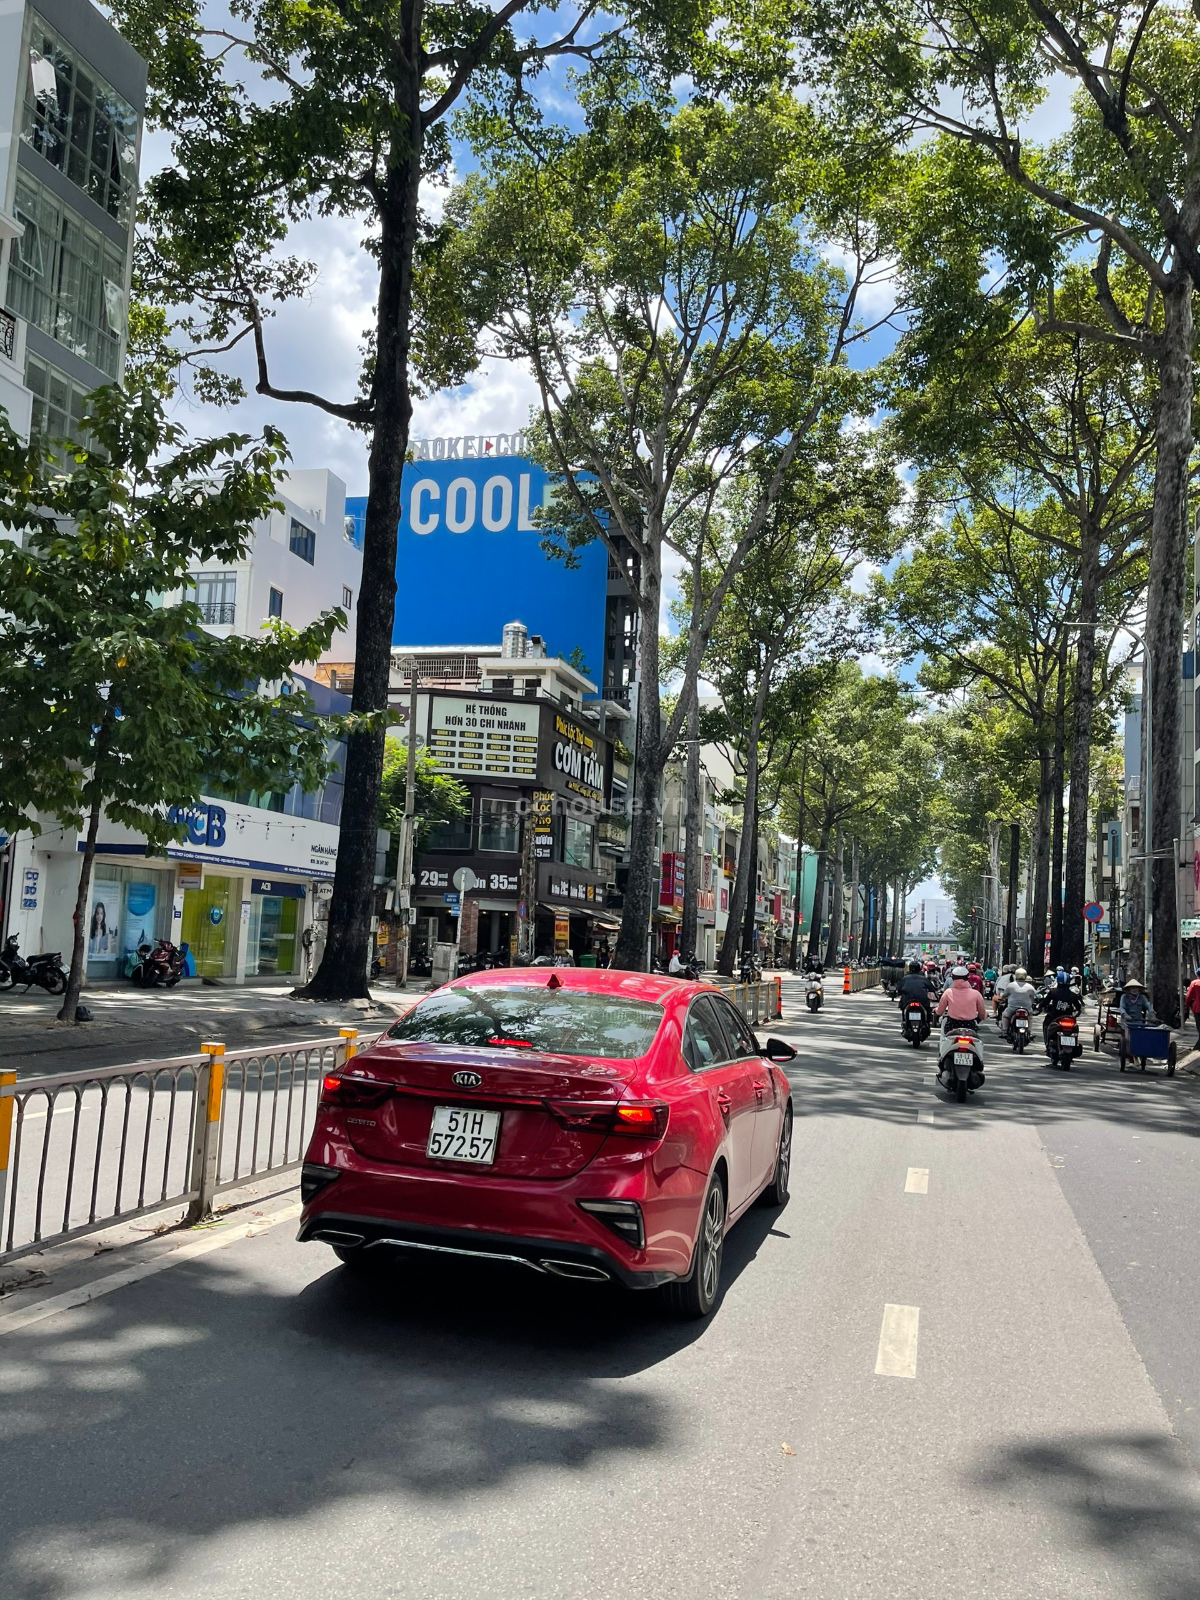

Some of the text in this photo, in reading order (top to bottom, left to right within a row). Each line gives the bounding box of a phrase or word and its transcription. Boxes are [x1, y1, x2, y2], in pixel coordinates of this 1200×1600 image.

[407, 436, 476, 460] AOKE
[466, 717, 477, 727] 30
[480, 718, 495, 728] CHI
[555, 742, 604, 790] CƠM TẤM
[420, 870, 439, 886] 29
[490, 874, 508, 890] 35
[456, 1074, 476, 1085] KIA
[448, 1111, 484, 1135] 51H
[430, 1132, 494, 1160] 572.57
